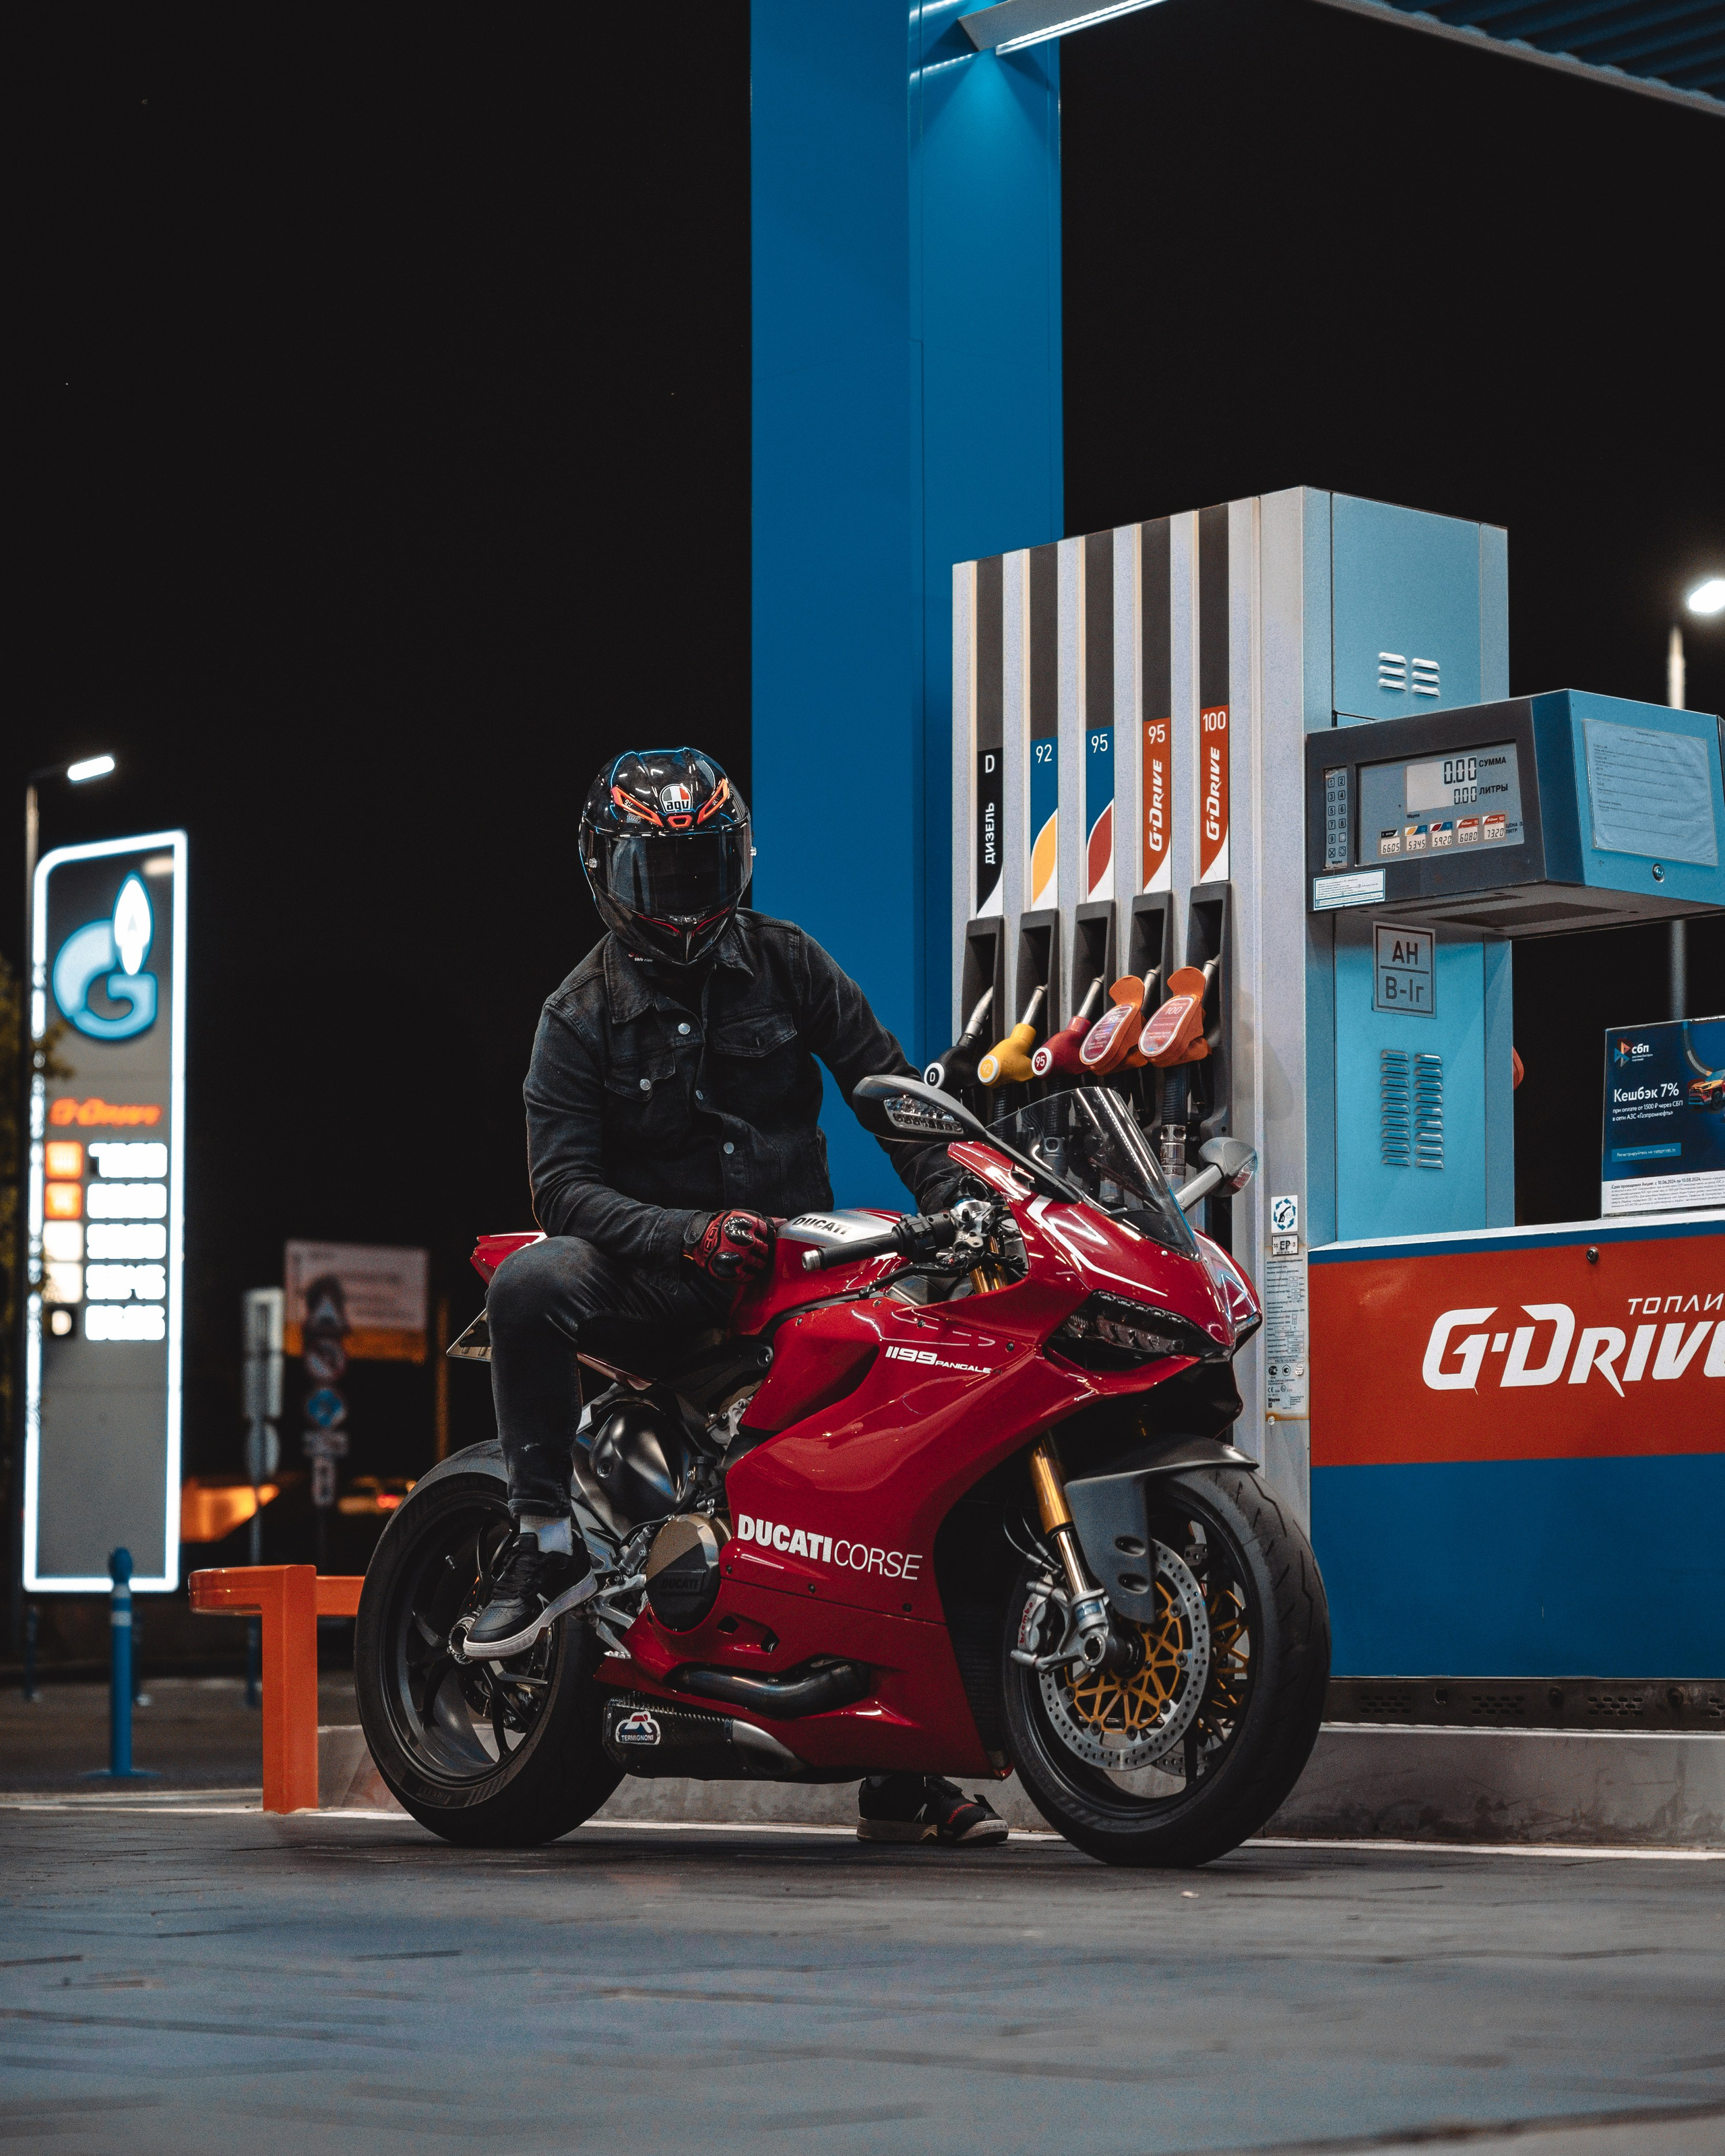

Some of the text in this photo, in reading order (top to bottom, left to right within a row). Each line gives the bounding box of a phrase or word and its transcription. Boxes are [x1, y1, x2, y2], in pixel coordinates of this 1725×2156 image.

[1203, 710, 1227, 732] 100
[1091, 733, 1108, 753] 95
[1148, 724, 1166, 744] 95
[1036, 744, 1053, 764] 92
[1479, 756, 1507, 767] СУММА
[985, 754, 995, 773] D
[1444, 757, 1477, 784] 0.00
[1454, 787, 1477, 805] 0.00
[1479, 784, 1508, 795] ЛИТРЫ
[666, 801, 689, 811] agv
[985, 801, 996, 865] ДИЗЕЛЬ
[1164, 1006, 1183, 1015] 100
[1631, 1043, 1650, 1054] сбп
[982, 1064, 991, 1074] 92
[1036, 1055, 1045, 1068] 95
[929, 1072, 935, 1082] D
[1613, 1082, 1679, 1103] Кешбэк 7%
[792, 1217, 852, 1235] DUCATI
[885, 1345, 938, 1365] 1199
[935, 1360, 992, 1374] PANIGALE
[737, 1513, 923, 1580] DUCATI CORSE
[1020, 1602, 1033, 1643] brembo
[621, 1734, 654, 1742] TERMIGNONI
